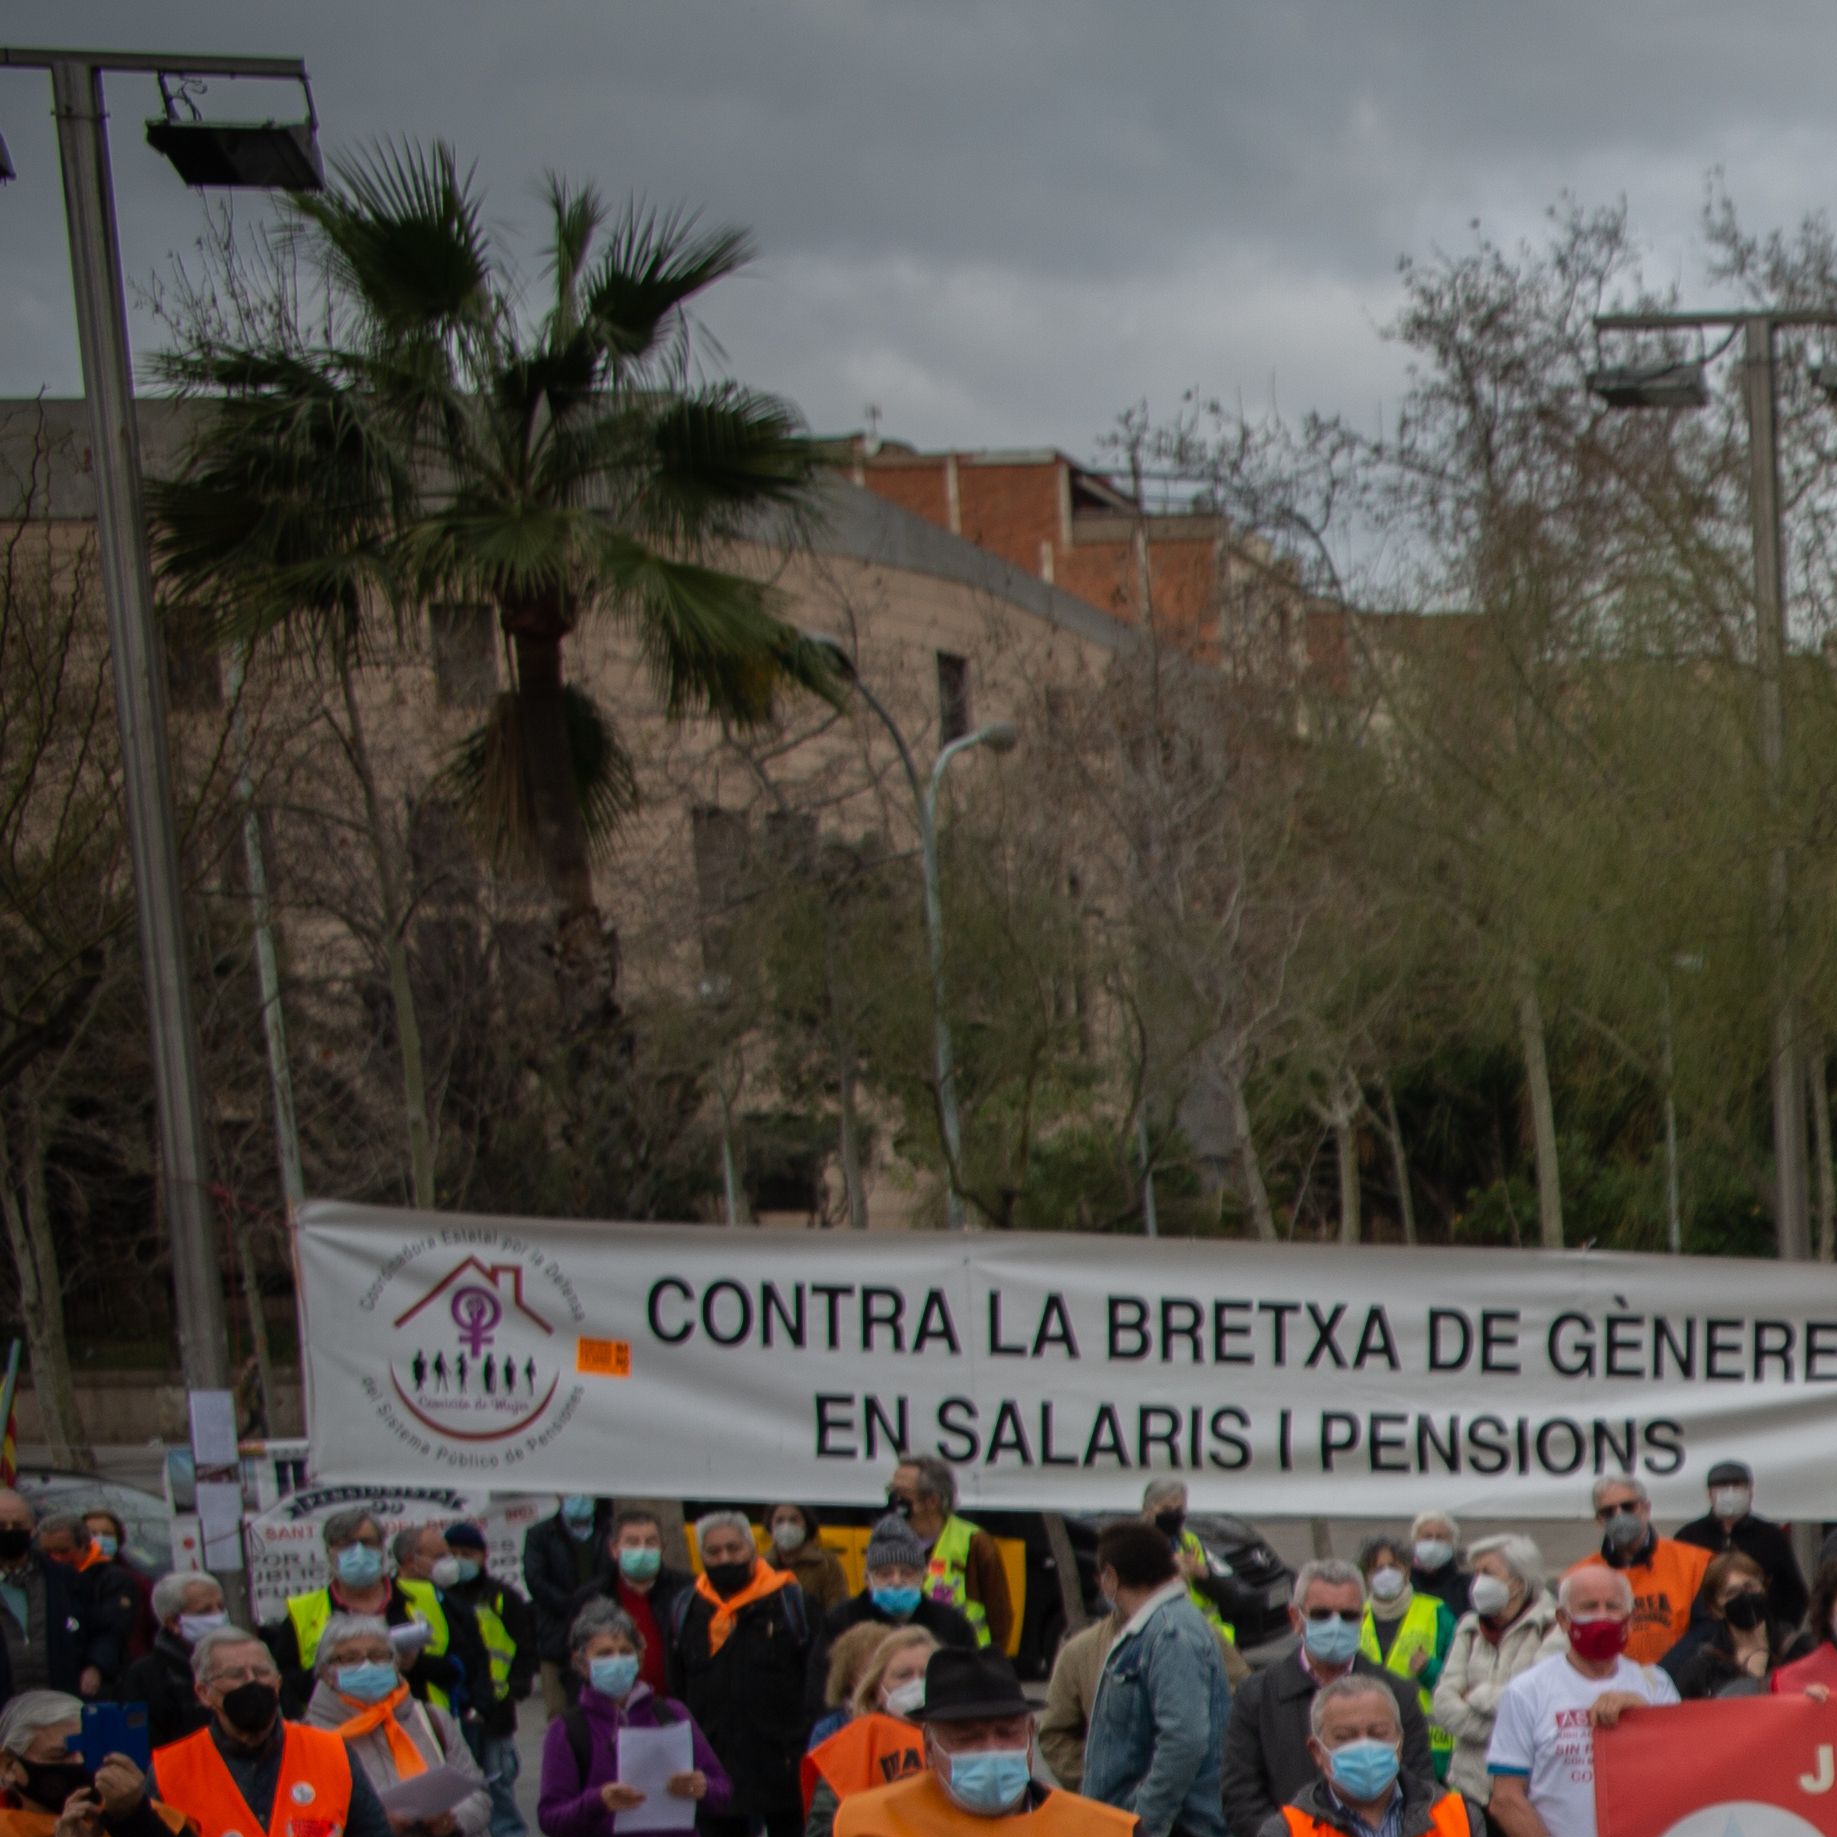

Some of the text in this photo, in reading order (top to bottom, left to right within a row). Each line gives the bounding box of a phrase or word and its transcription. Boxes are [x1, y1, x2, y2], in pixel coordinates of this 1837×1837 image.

[441, 1228, 498, 1245] Estatal
[502, 1235, 528, 1255] por
[531, 1248, 546, 1267] la
[545, 1263, 586, 1322] Defensa
[647, 1276, 960, 1354] CONTRA
[989, 1290, 1079, 1359] LA
[1107, 1295, 1399, 1371] BRETXA
[1428, 1308, 1520, 1375] DE
[377, 1402, 432, 1456] Sistema
[436, 1446, 501, 1469] Público
[505, 1447, 525, 1466] de
[526, 1385, 586, 1452] Pensiones
[815, 1393, 1686, 1475] EN SALARIS I PENSIONS
